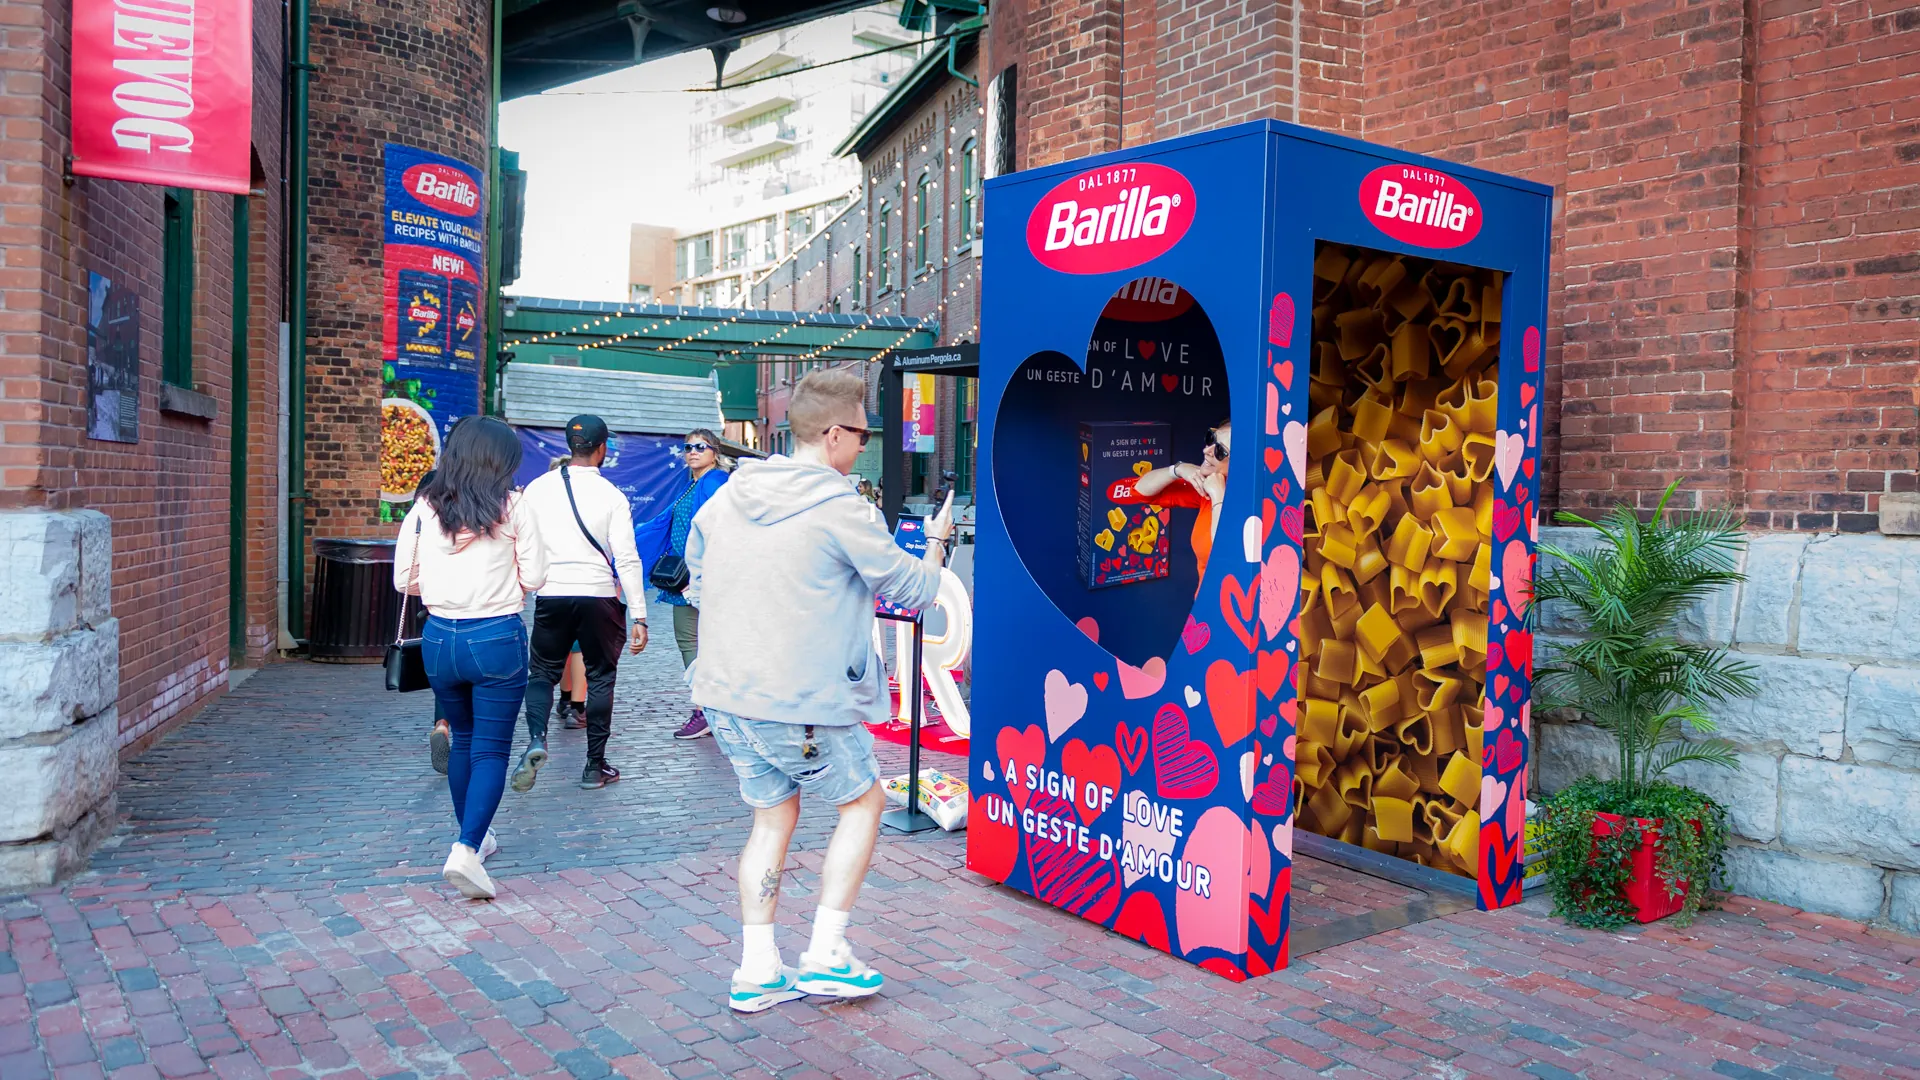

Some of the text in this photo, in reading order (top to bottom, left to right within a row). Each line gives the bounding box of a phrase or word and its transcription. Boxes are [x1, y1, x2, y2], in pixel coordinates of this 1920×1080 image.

[1079, 168, 1136, 191] DAL 1877
[1403, 168, 1445, 187] DAL 1877
[391, 210, 439, 229] ELEVATE
[440, 219, 462, 235] YOUR
[394, 223, 436, 241] RECIPES
[438, 231, 459, 246] WITH
[432, 253, 465, 275] NEW!
[1103, 340, 1117, 352] OF
[1027, 368, 1042, 381] UN
[1046, 370, 1080, 384] GESTE
[909, 380, 921, 443] ice cream
[1116, 438, 1129, 446] SIGN
[1130, 438, 1137, 446] OF
[1112, 449, 1129, 458] GESTE
[1005, 758, 1184, 838] A SIGN OF LOVE
[987, 796, 1211, 898] UN GESTE D'AMOUR
